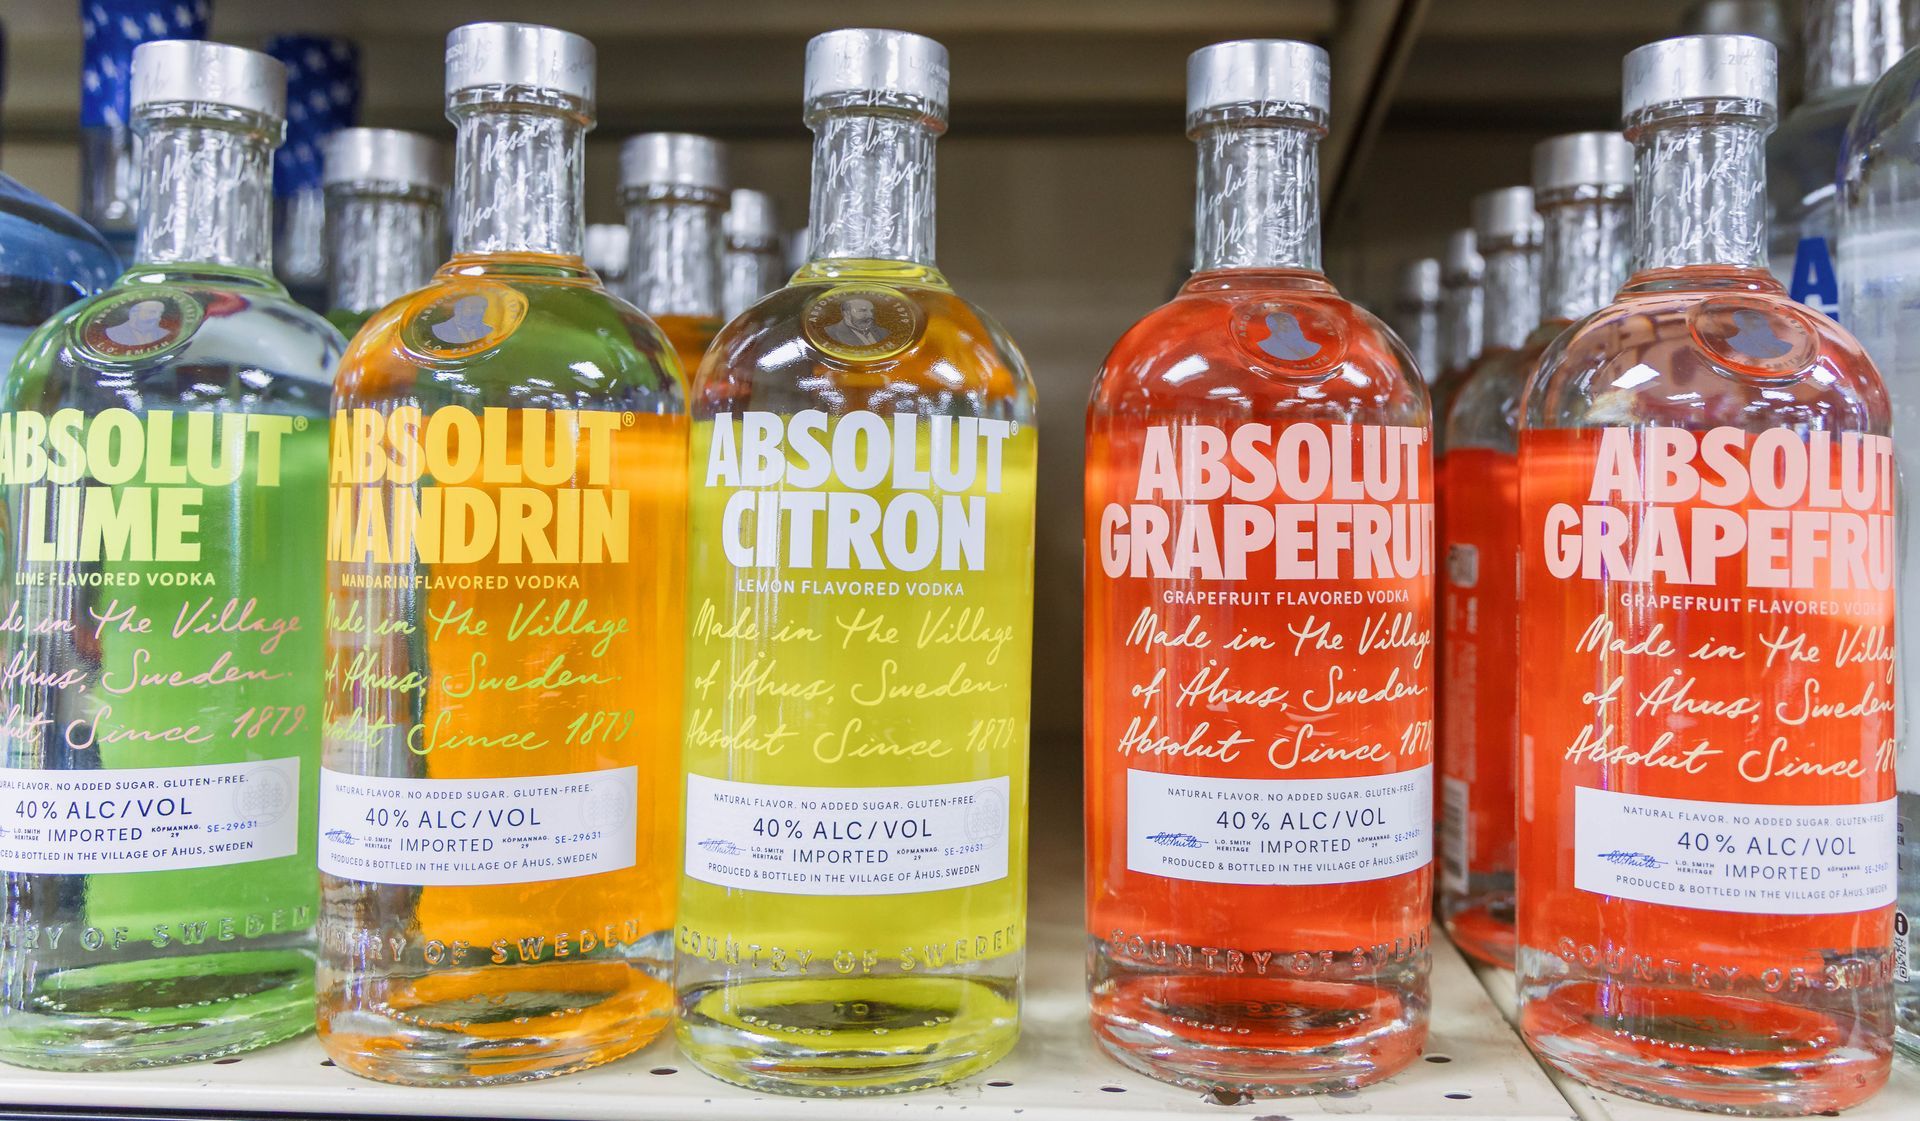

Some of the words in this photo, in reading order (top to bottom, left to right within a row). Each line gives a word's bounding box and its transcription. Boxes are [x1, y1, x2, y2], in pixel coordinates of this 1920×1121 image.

[1588, 426, 1893, 511] ABSOLUT
[27, 487, 203, 561] LIME
[327, 486, 630, 564] MANDRIN
[722, 490, 986, 571] CITRON
[16, 573, 44, 586] LIME
[50, 573, 140, 586] FLAVORED
[147, 573, 215, 586] VODKA
[341, 574, 409, 589] MANDARIN
[415, 575, 509, 590] FLAVORED
[515, 574, 580, 589] VODKA
[738, 578, 795, 593] LEMON
[801, 580, 899, 596] FLAVORED
[906, 582, 964, 596] VODKA
[1163, 590, 1271, 606] GRAPEFRUIT
[1277, 591, 1363, 606] FLAVORED
[1367, 589, 1409, 604] VODKA
[1621, 592, 1741, 613] GRAPEFRUIT
[1748, 599, 1839, 615] FLAVORED
[90, 599, 152, 639] the
[172, 597, 301, 654] Village
[428, 600, 488, 641] the
[507, 598, 630, 657] Village
[692, 598, 760, 646] Made
[772, 620, 822, 642] in
[836, 607, 899, 649] the
[917, 606, 1014, 665] Village
[1126, 607, 1212, 654] Made
[1223, 628, 1275, 650] in
[1287, 614, 1344, 656] the
[1358, 611, 1431, 669] Village
[1575, 613, 1675, 662] Made
[1689, 637, 1746, 660] in
[1759, 626, 1820, 667] the
[102, 649, 293, 694] Sweden.
[442, 652, 622, 698] Sweden.
[695, 659, 721, 700] of
[728, 651, 836, 704] Åhus,
[850, 659, 1008, 706] Sweden.
[1132, 668, 1166, 708] of
[1176, 659, 1291, 712] Åhus,
[1582, 676, 1624, 717] of
[1635, 668, 1761, 724] Åhus,
[66, 705, 214, 749] Since
[407, 710, 549, 755] Since
[686, 708, 799, 756] Absolut
[813, 718, 952, 763] Since
[1117, 716, 1255, 763] Absolut
[1268, 723, 1390, 769] Since
[1564, 724, 1723, 774] Absolut
[1738, 736, 1867, 782] Since
[18, 782, 52, 790] FLAVOR.
[116, 781, 158, 790] SUGAR.
[164, 775, 248, 788] GLUTEN-FREE.
[367, 789, 402, 799] FLAVOR.
[408, 791, 422, 799] NO
[467, 791, 508, 799] SUGAR.
[514, 784, 592, 797] GLUTEN-FREE.
[715, 794, 751, 805] NATURAL
[755, 799, 796, 808] FLAVOR.
[820, 802, 858, 810] ADDED
[863, 802, 902, 810] SUGAR.
[907, 796, 976, 808] GLUTEN-FREE.
[1168, 788, 1213, 799] NATURAL
[1218, 792, 1262, 801] FLAVOR.
[1287, 793, 1323, 801] ADDED
[1327, 791, 1362, 800] SUGAR.
[16, 801, 57, 819] 40%
[67, 798, 192, 819] ALC/VOL
[366, 808, 408, 827] 40%
[419, 808, 540, 828] ALC/VOL
[1217, 811, 1269, 830] 40%
[1280, 808, 1385, 830] ALC/VOL
[1624, 806, 1673, 819] NATURAL
[1679, 812, 1728, 824] FLAVOR.
[1734, 816, 1749, 824] NO
[1755, 818, 1792, 826] ADDED
[49, 828, 142, 841] IMPORTED
[207, 821, 257, 832] SE-29631
[753, 818, 802, 838] 40%
[813, 819, 931, 840] ALC/VOL
[401, 839, 493, 852] IMPORTED
[555, 832, 600, 844] SE-29631
[1261, 839, 1350, 853] IMPORTED
[1678, 832, 1735, 853] 40%
[1747, 837, 1855, 856] ALC/VOL
[22, 852, 60, 860] BOTTLED
[78, 852, 97, 860] THE
[101, 850, 148, 859] VILLAGE
[153, 849, 167, 857] OF
[172, 847, 205, 856] ÅHUS,
[209, 842, 253, 853] SWEDEN
[794, 849, 888, 863] IMPORTED
[945, 844, 982, 856] SE-29631
[1163, 856, 1214, 869] PRODUCED
[1228, 863, 1274, 872] BOTTLED
[1317, 861, 1355, 871] VILLAGE
[1359, 860, 1370, 868] OF
[1396, 850, 1418, 862] SWEDEN
[373, 860, 412, 870] BOTTLED
[430, 863, 448, 871] THE
[454, 862, 499, 870] VILLAGE
[504, 861, 517, 869] OF
[558, 853, 597, 864] SWEDEN
[709, 863, 750, 877] PRODUCED
[762, 871, 806, 881] BOTTLED
[811, 874, 821, 882] IN
[850, 874, 893, 882] VILLAGE
[898, 873, 911, 881] OF
[946, 865, 979, 876] SWEDEN
[1726, 864, 1820, 879] IMPORTED
[1617, 875, 1674, 890] PRODUCED
[1690, 885, 1740, 896] BOTTLED
[1761, 890, 1780, 899] THE
[1785, 891, 1825, 899] VILLAGE
[1829, 890, 1840, 899] OF
[1111, 928, 1272, 975] COUNTRY
[1558, 937, 1740, 990] COUNTRY
